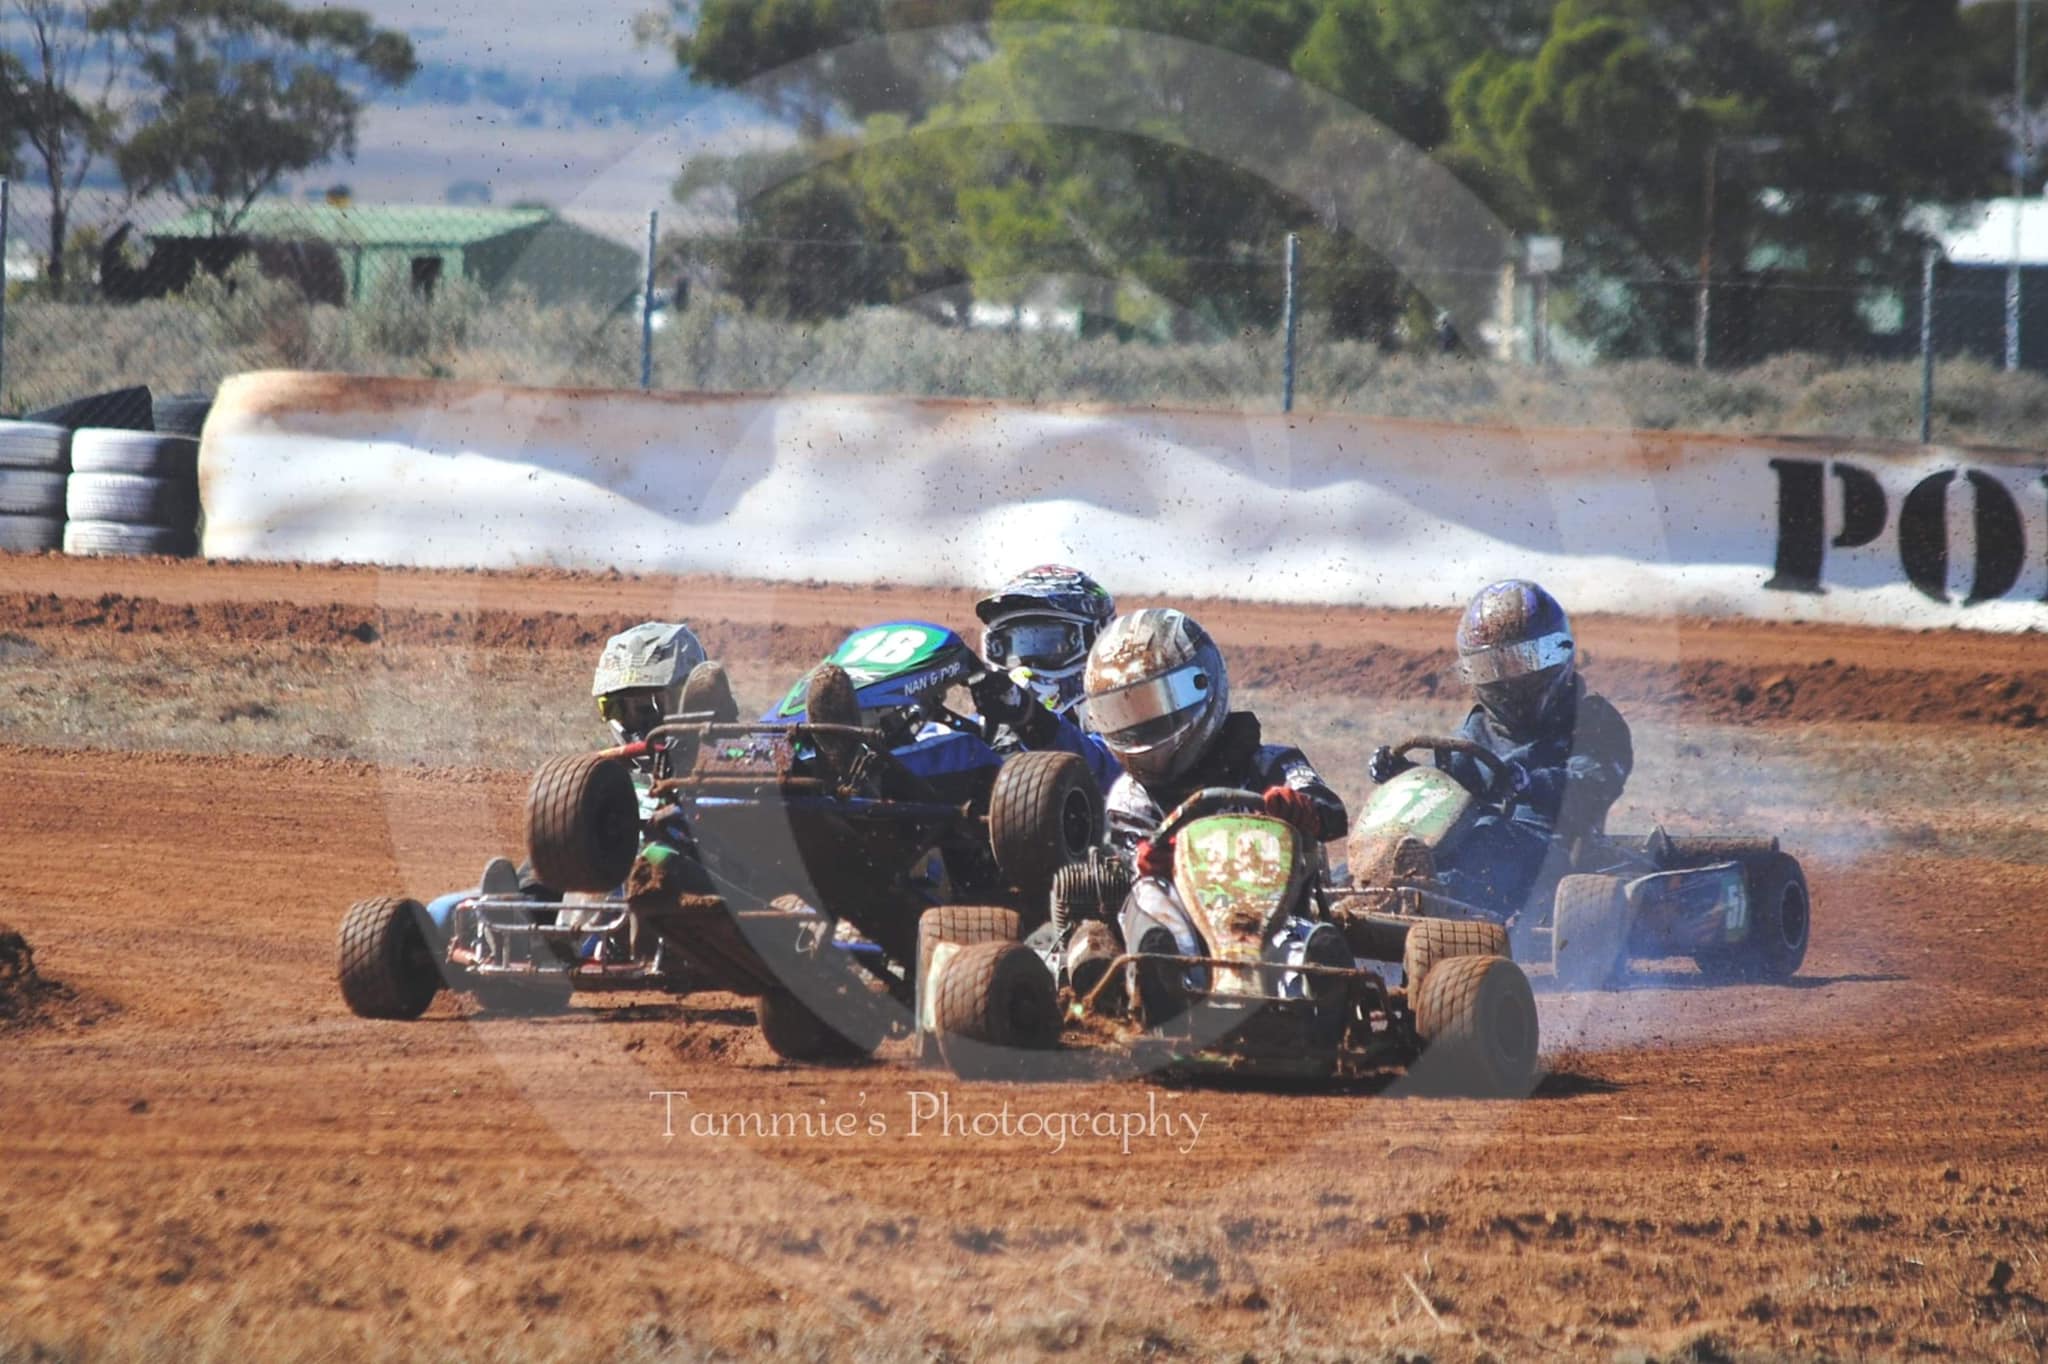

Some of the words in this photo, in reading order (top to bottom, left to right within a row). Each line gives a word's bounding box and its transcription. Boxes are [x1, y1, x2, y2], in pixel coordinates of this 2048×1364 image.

[1763, 458, 2048, 608] PO
[840, 629, 928, 665] 18
[904, 675, 927, 697] NAN
[940, 662, 961, 682] POP
